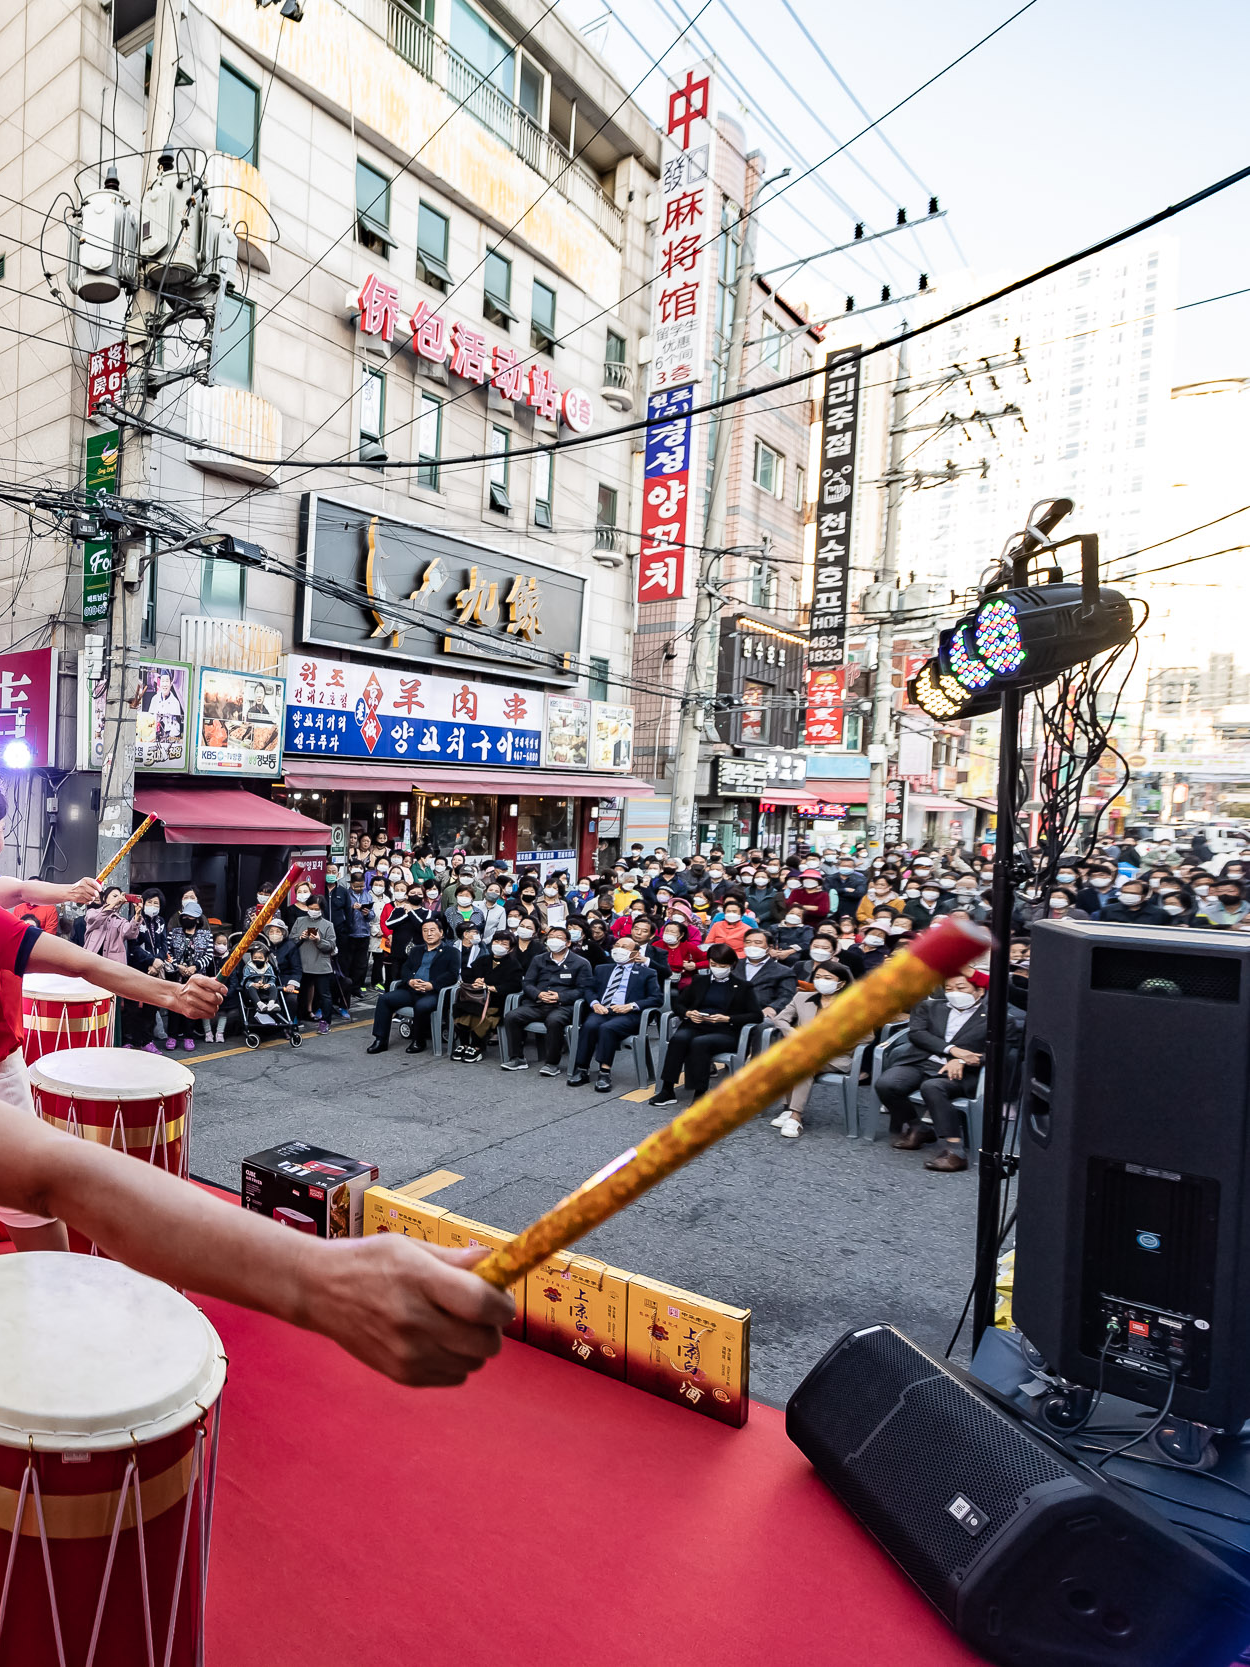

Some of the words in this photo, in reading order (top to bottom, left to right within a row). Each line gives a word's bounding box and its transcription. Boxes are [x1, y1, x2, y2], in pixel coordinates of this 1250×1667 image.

[667, 70, 710, 151] 中
[658, 188, 705, 324] 麻将馆
[358, 273, 559, 421] 侨包活动站
[93, 372, 127, 396] 房6
[826, 351, 857, 459] 요리주점
[641, 479, 687, 596] 양꼬치
[299, 662, 345, 688] 원조
[393, 678, 528, 726] 羊肉串
[201, 750, 217, 760] KBS
[390, 720, 514, 763] 양꼬치구이
